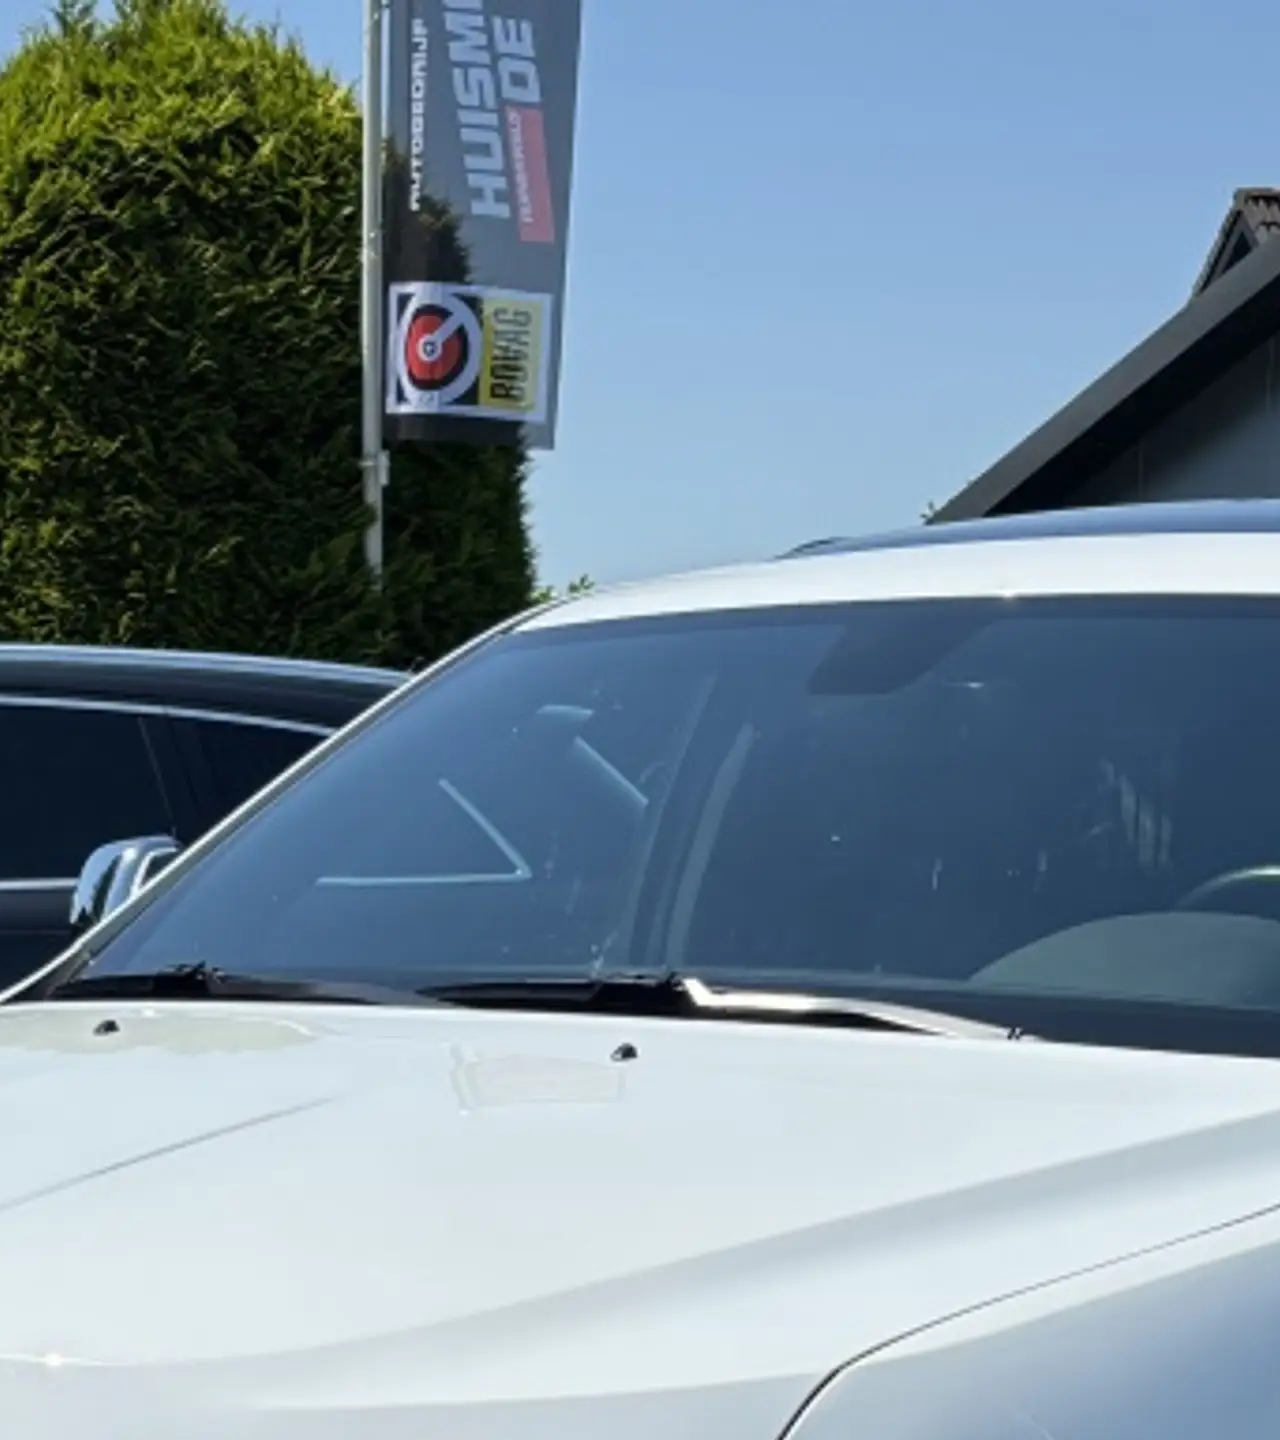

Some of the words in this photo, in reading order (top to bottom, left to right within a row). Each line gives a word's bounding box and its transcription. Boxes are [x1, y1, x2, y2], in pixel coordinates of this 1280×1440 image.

[491, 15, 542, 103] DE
[441, 0, 511, 219] HUISM
[489, 307, 533, 403] BOVAG
